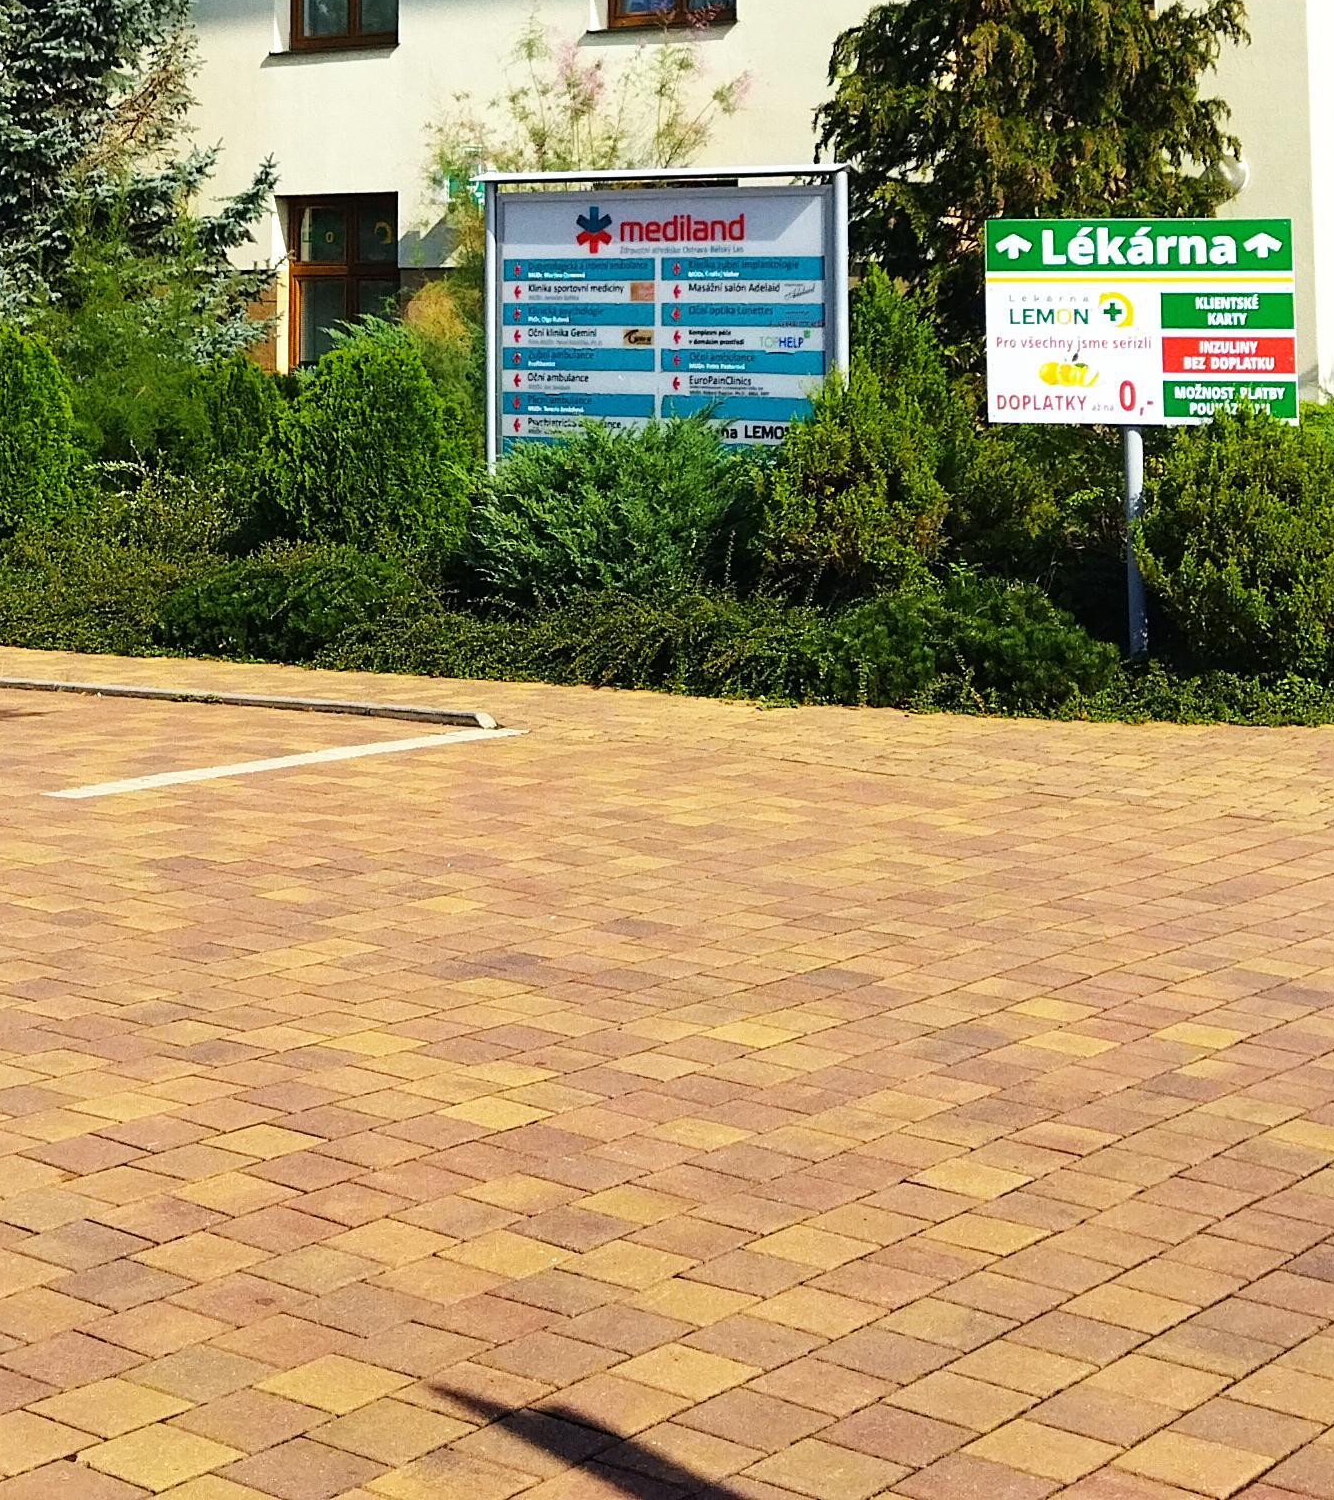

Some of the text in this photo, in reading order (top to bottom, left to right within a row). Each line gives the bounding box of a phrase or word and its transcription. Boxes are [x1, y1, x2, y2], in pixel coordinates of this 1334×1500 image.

[620, 213, 745, 242] mediland
[1042, 227, 1237, 265] Lékárna
[528, 284, 552, 293] Klinika
[554, 284, 588, 295] sportovní
[688, 283, 722, 292] Masážní
[725, 283, 746, 292] salón
[1194, 294, 1259, 310] KLIENTSKÉ
[1009, 308, 1089, 325] LEMON
[1207, 312, 1247, 326] KARTY
[528, 328, 597, 337] Oční klinika Gemini
[996, 337, 1017, 349] Pro
[1021, 336, 1073, 352] všechny
[1076, 336, 1108, 352] jsme
[1198, 340, 1259, 354] INZULINY
[1183, 356, 1275, 371] BEZ DOPLATKU
[528, 372, 589, 382] Oční ambulance
[689, 375, 751, 385] EuroPainClinics
[1174, 384, 1285, 400] MOŽNOST PLATBY
[997, 395, 1087, 411] DOPLATKY
[744, 425, 789, 440] LEMO
